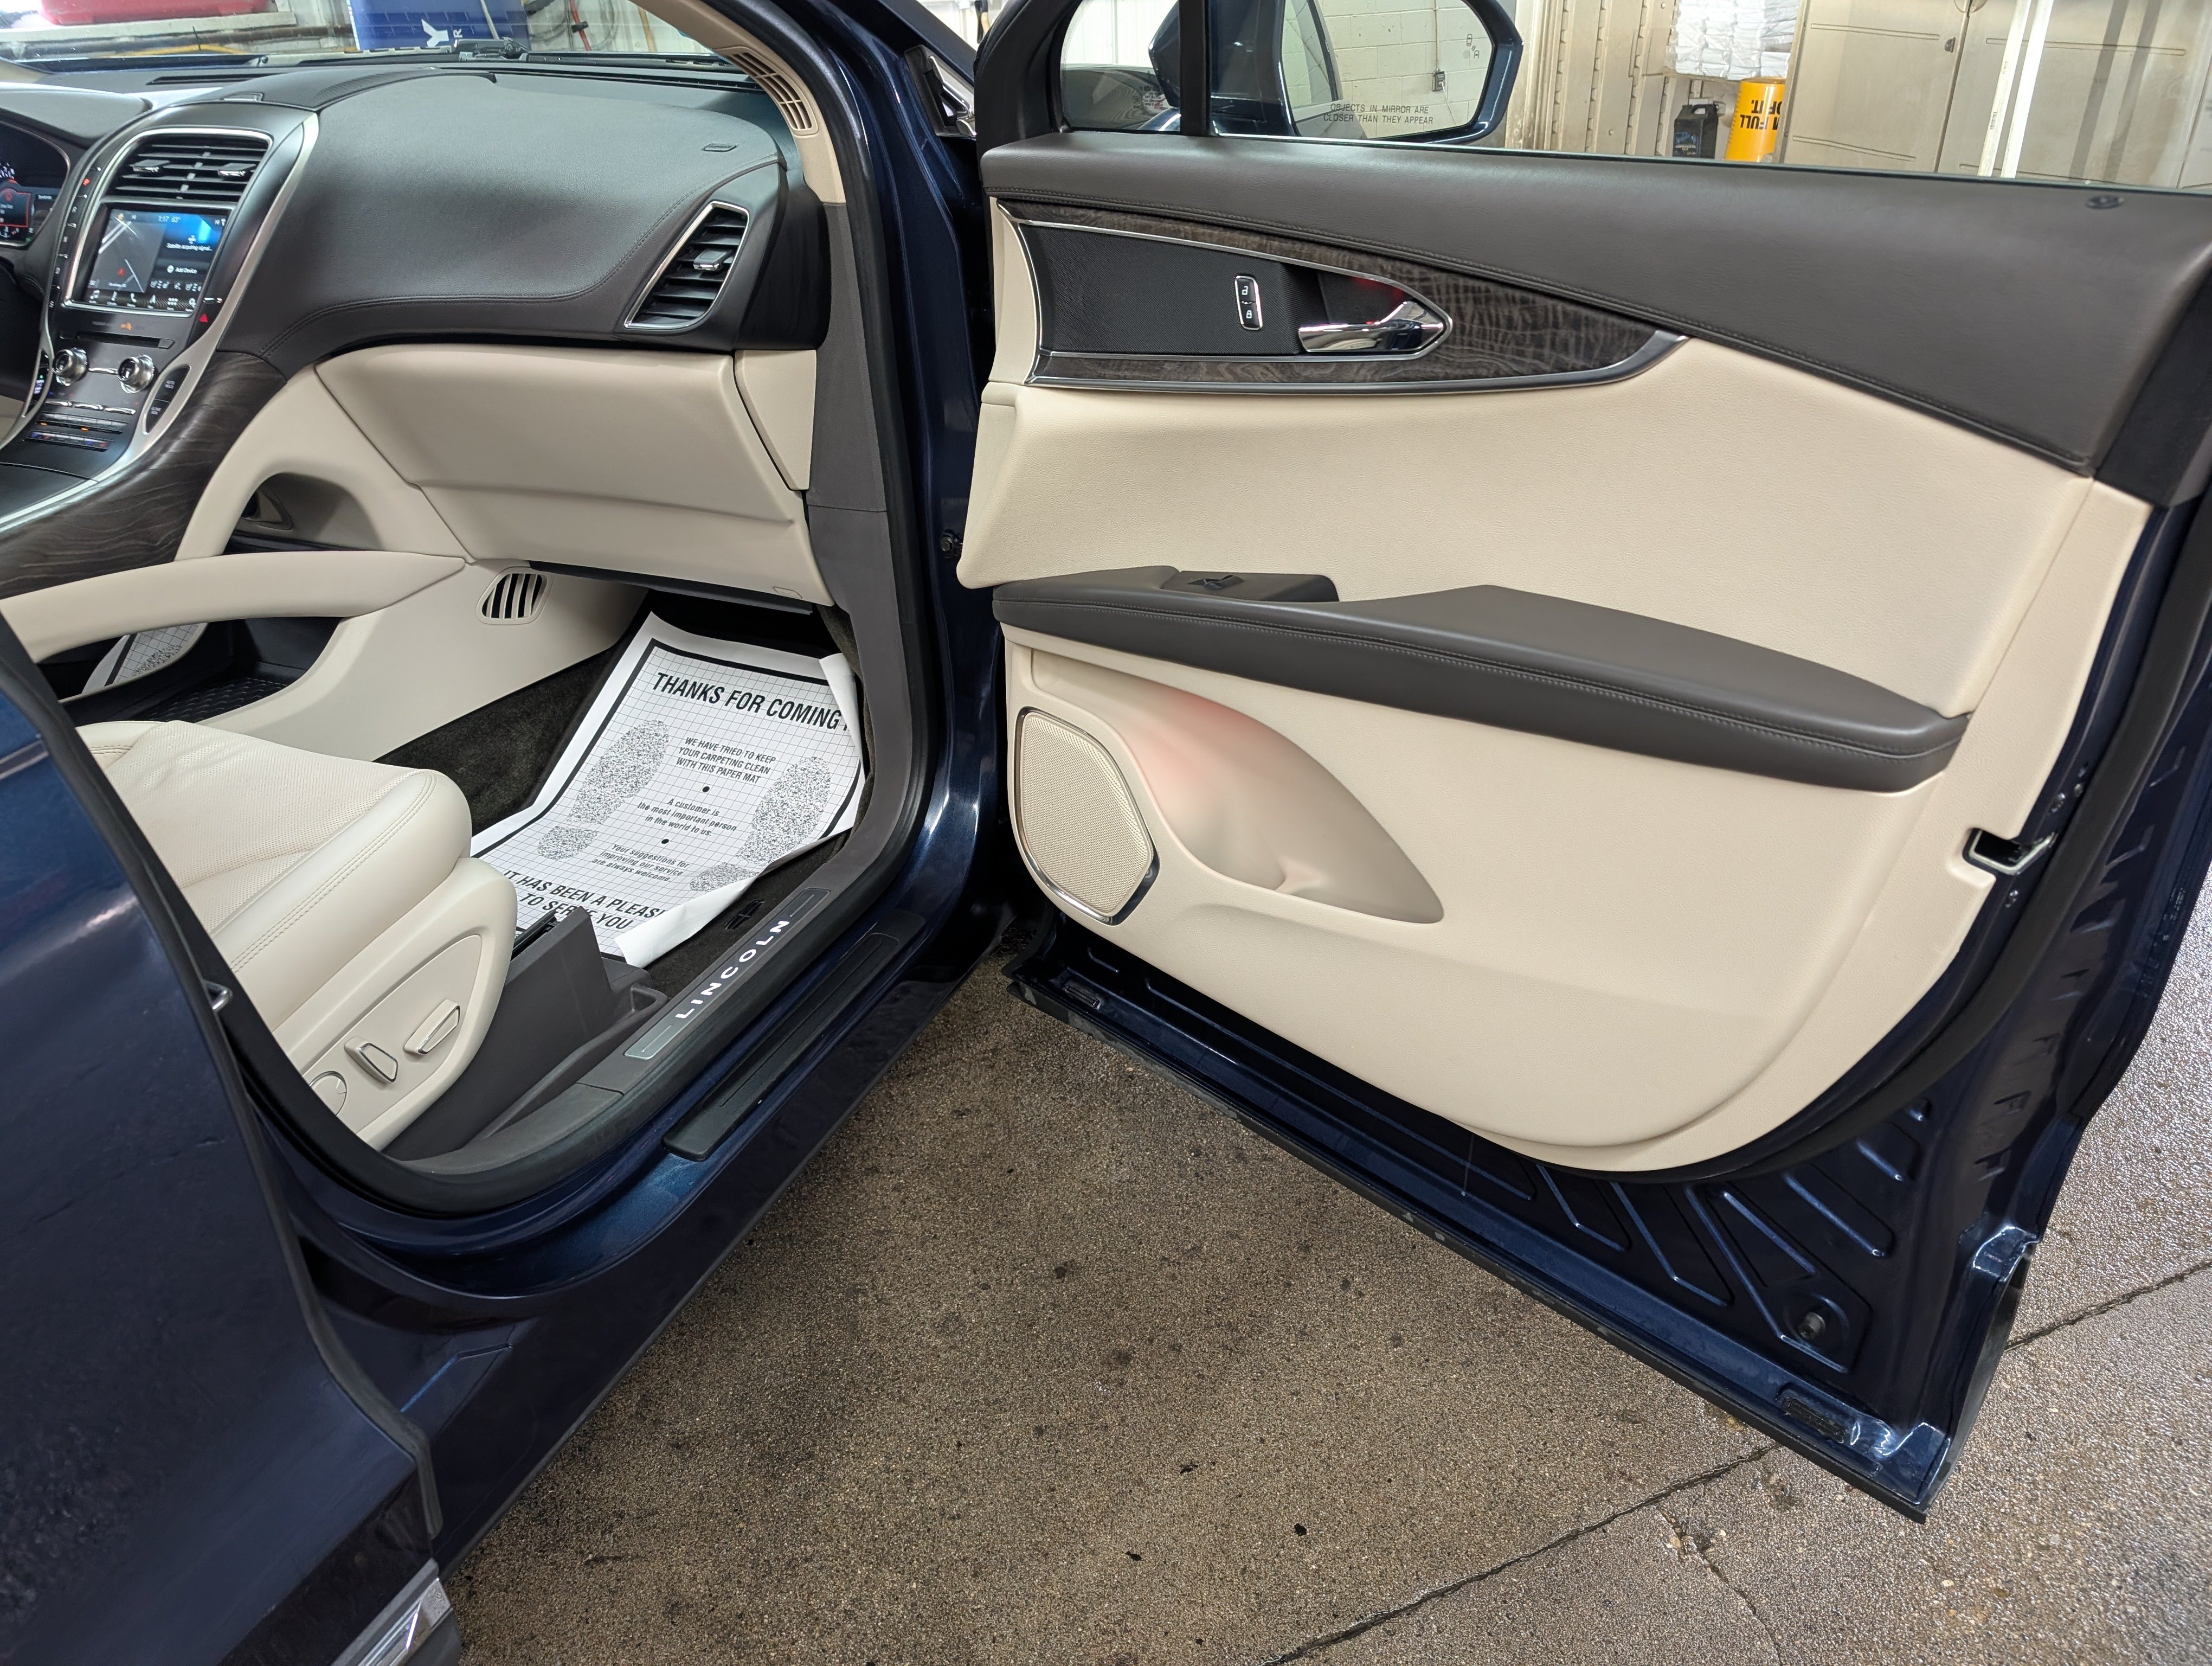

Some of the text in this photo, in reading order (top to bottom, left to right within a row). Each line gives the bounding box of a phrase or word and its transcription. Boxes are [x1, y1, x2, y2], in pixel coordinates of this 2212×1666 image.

[1323, 113, 1433, 124] CLOSER THAN THEY APPEAR
[1330, 103, 1365, 112] OBJECTS
[1370, 104, 1377, 112] IN
[1382, 105, 1410, 113] MIRROR
[1740, 114, 1768, 130] FULL
[652, 672, 842, 730] THANKS FOR COMING
[678, 747, 771, 774] YOUR CARPETING CLEAN
[685, 737, 776, 764] WE HAVE TRIED TO KEEP
[676, 757, 761, 784] WITH THIS PAPER MAT
[637, 802, 737, 832] the most important person
[674, 801, 711, 815] customer
[711, 809, 720, 817] is
[654, 817, 667, 825] the
[668, 821, 691, 831] world
[691, 825, 700, 833] to
[600, 850, 639, 866] improving
[654, 865, 684, 876] service
[611, 844, 630, 854] Your
[629, 850, 677, 866] suggestions
[606, 862, 635, 873] always
[635, 869, 671, 882] welcome.
[504, 870, 521, 880] IT
[516, 876, 552, 891] HAS
[550, 886, 595, 903] BEEN
[590, 895, 607, 906] A
[519, 893, 545, 906] TO
[596, 913, 634, 930] YOU
[675, 920, 790, 1020] LINCOLN
